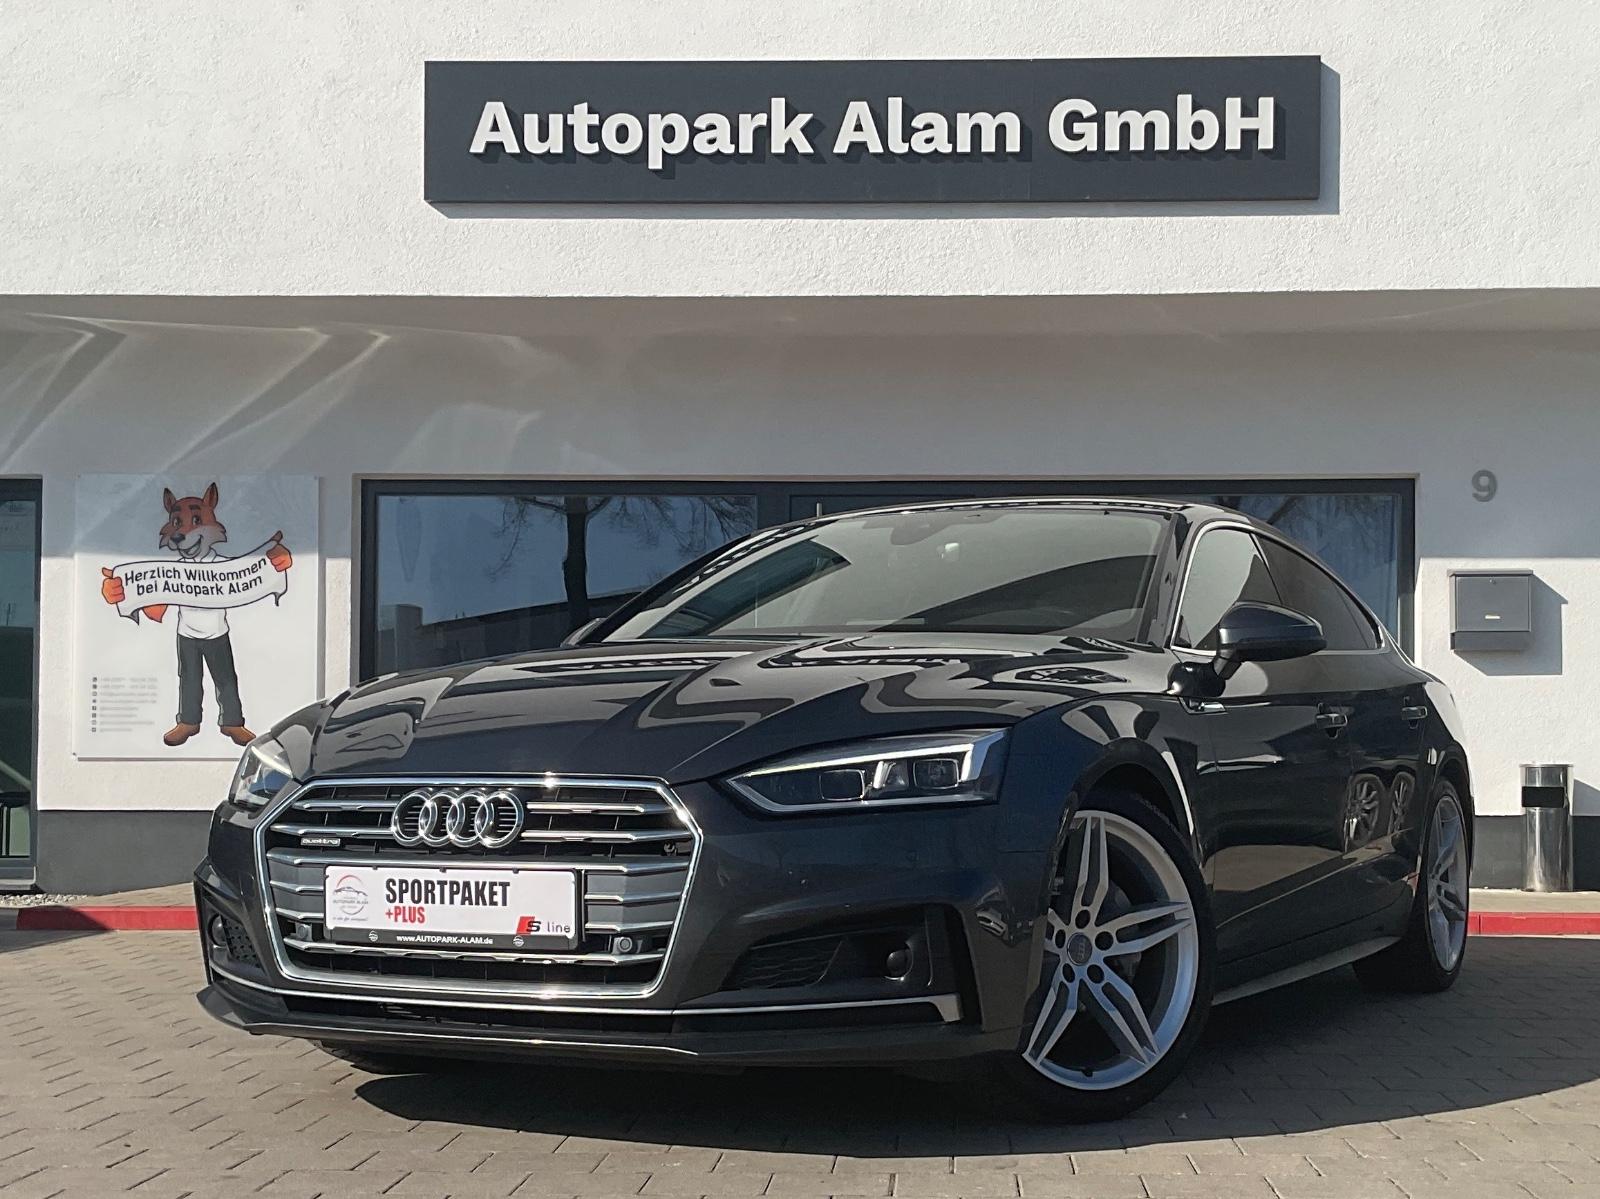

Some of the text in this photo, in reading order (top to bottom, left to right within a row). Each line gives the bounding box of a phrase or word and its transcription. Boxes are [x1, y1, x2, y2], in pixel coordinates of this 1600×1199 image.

[469, 93, 1275, 170] Autopark Alam GmbH
[1471, 469, 1498, 502] 9
[125, 557, 267, 586] Herzlich Willkommen
[136, 575, 262, 597] bei Autopark Alam
[385, 878, 511, 907] SPORTPAKET
[385, 905, 426, 924] +PLUS
[396, 934, 493, 945] www.AUTOPARK-ALAM.de
[547, 921, 571, 934] line
